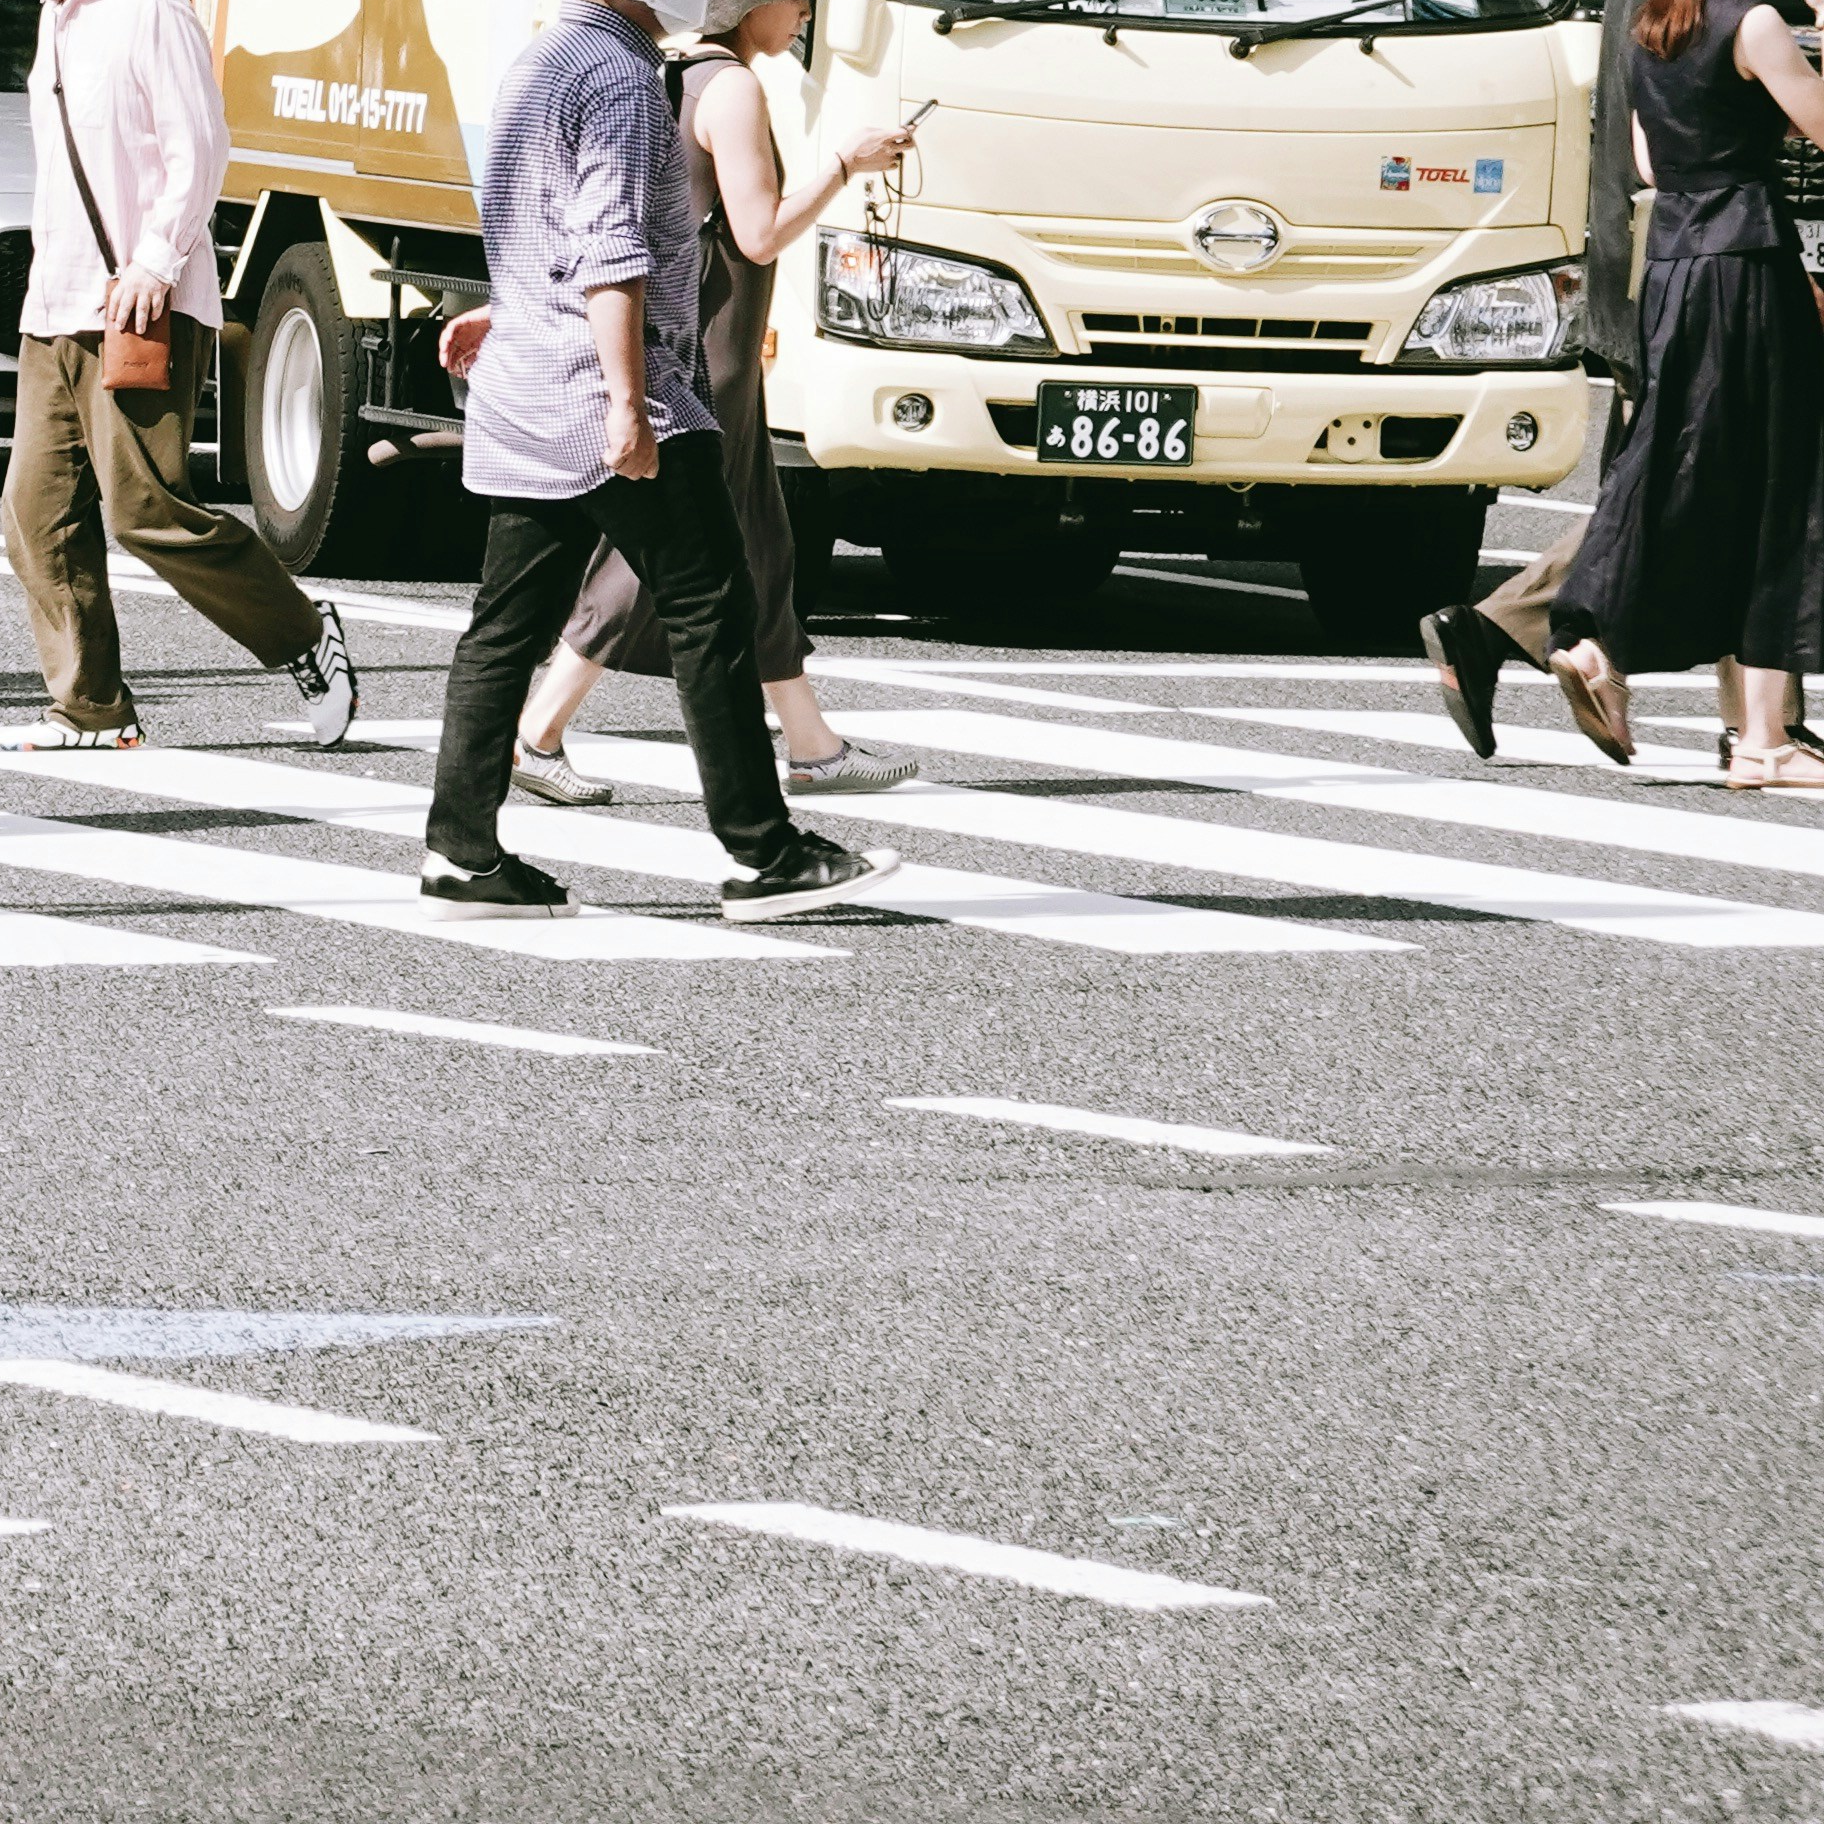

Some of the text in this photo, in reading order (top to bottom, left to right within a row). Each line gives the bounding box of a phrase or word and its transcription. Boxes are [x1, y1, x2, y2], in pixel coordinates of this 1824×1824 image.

[270, 74, 327, 123] TOELL
[1415, 167, 1471, 183] TOELL
[1076, 388, 1160, 414] 横浜 101
[1045, 415, 1189, 462] あ 86-86
